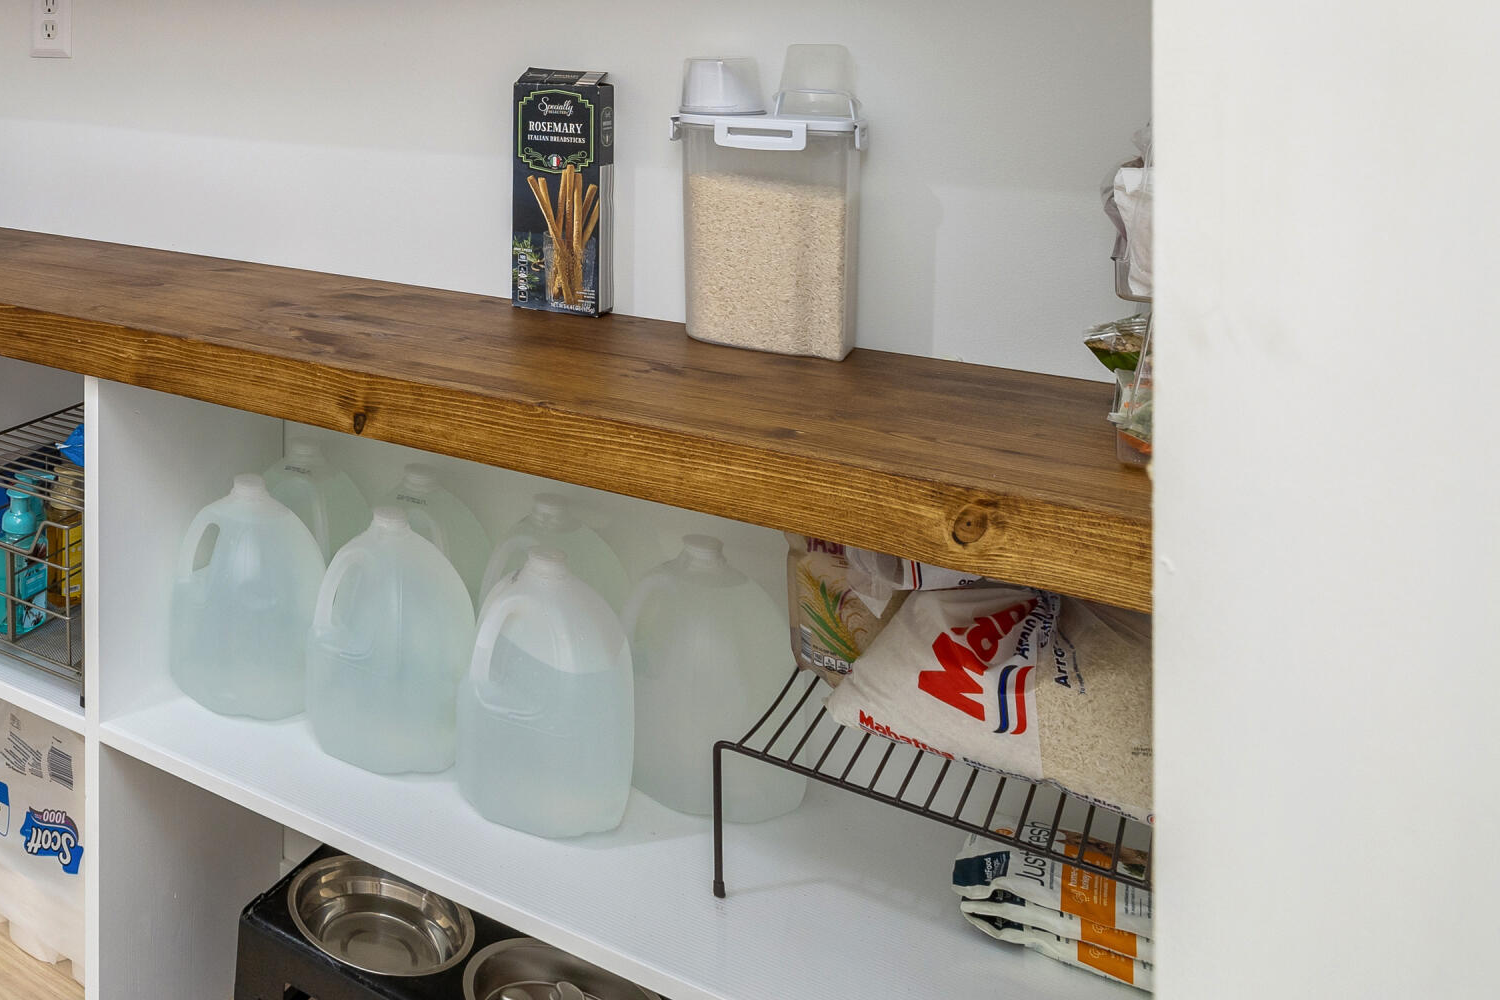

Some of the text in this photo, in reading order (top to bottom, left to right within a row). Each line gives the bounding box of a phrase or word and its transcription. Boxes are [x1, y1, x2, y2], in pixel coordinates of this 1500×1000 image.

[537, 96, 574, 117] Specially
[528, 120, 583, 134] ROSEMARY
[527, 134, 586, 144] ITALIAN BREADSTICKS
[858, 709, 955, 761] Mahatma
[41, 809, 67, 824] 1000
[27, 826, 76, 866] Scott
[1014, 820, 1051, 887] Justresh
